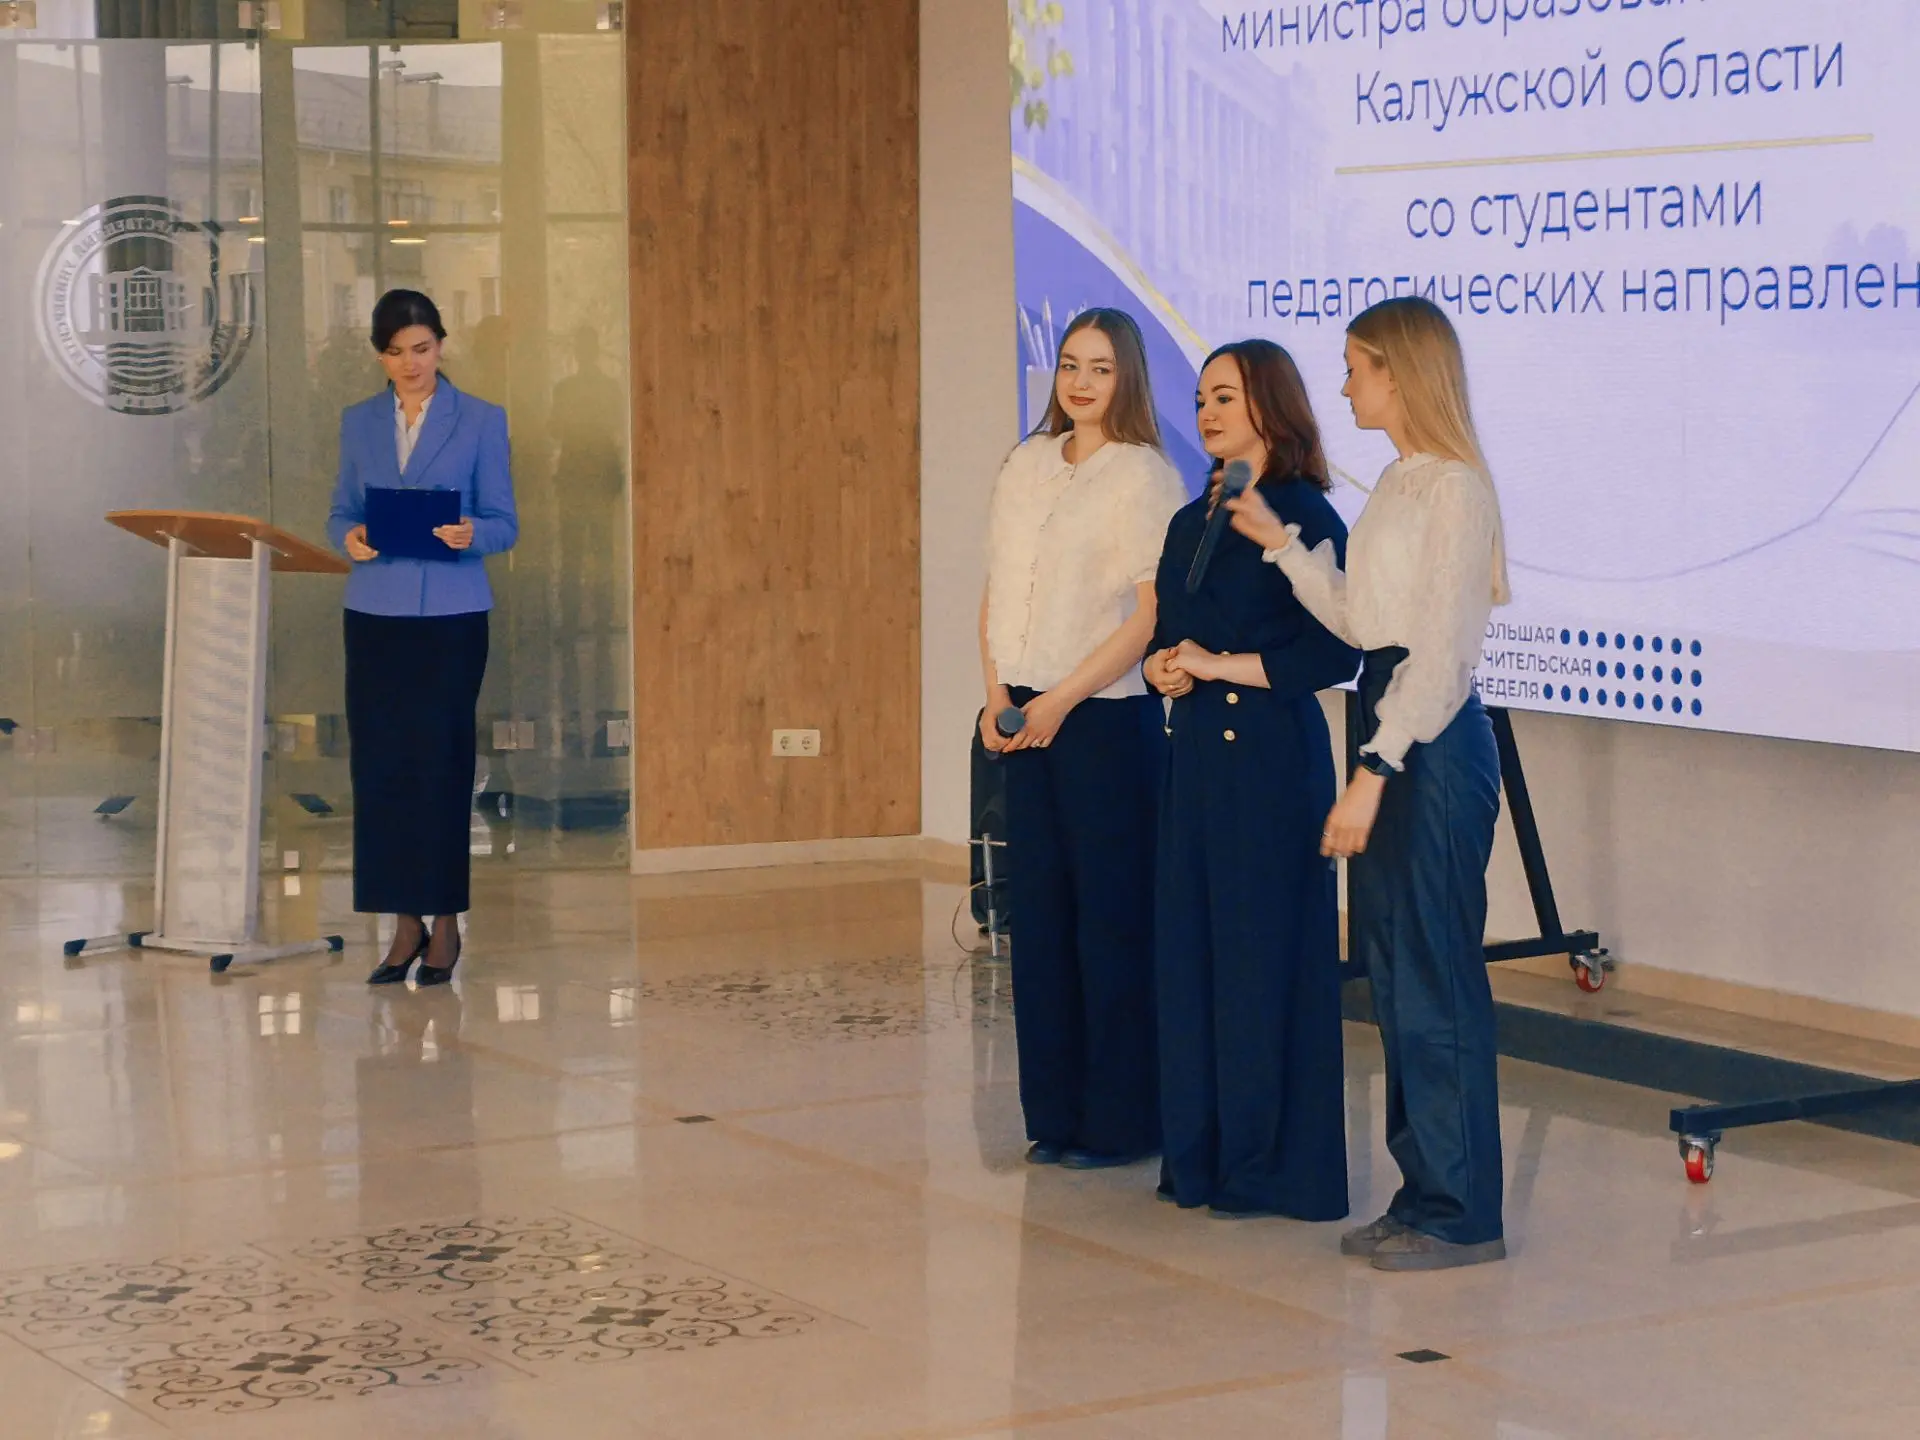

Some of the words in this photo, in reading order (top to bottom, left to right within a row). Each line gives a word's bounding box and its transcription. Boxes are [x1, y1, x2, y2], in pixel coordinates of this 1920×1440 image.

[1222, 0, 1426, 53] министра
[1356, 47, 1606, 133] Калужской
[1624, 36, 1843, 104] области
[1406, 196, 1456, 239] со
[1470, 180, 1762, 249] студентами
[1247, 269, 1606, 326] педагогических
[1622, 261, 1920, 327] направлен
[1484, 621, 1556, 645] ОЛЬШАЯ
[1474, 674, 1540, 700] НЕДЕЛЯ
[1481, 648, 1593, 678] ЧИТЕЛЬСКАЯ
